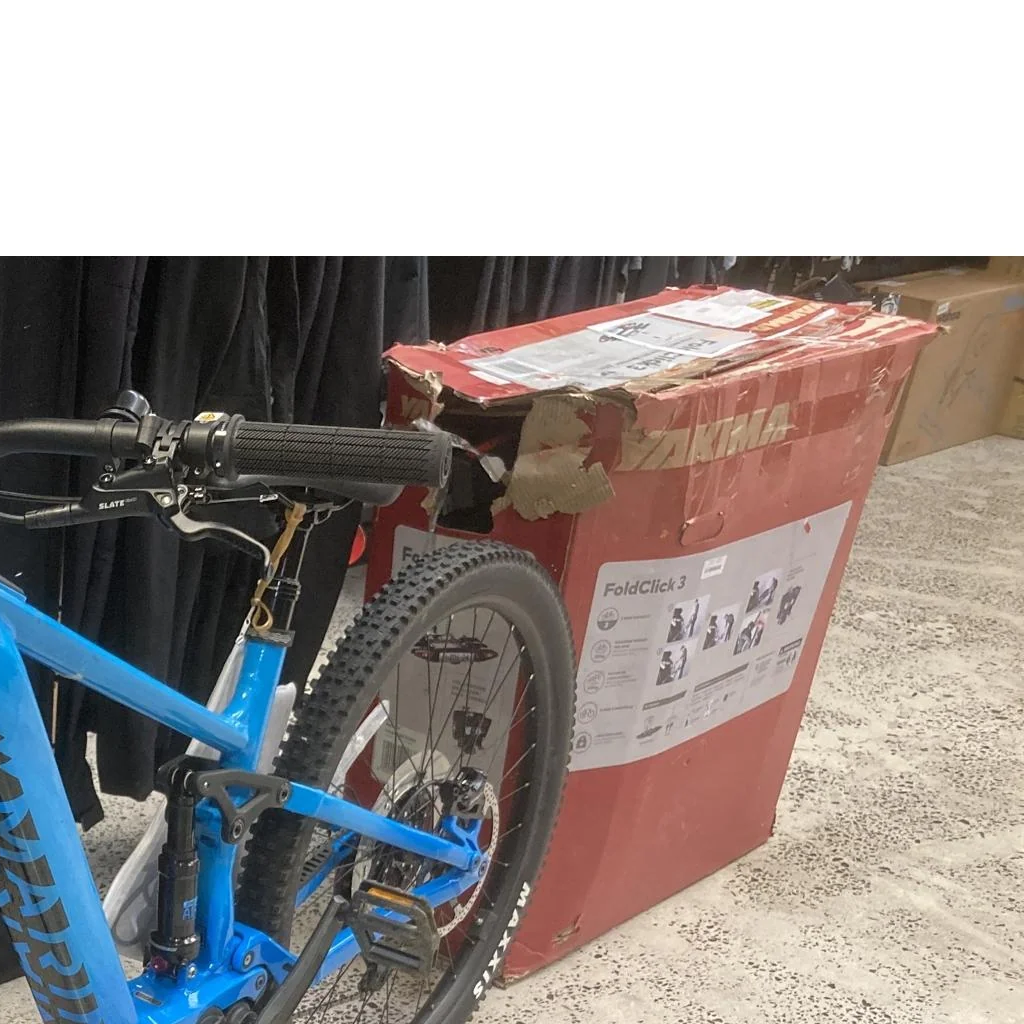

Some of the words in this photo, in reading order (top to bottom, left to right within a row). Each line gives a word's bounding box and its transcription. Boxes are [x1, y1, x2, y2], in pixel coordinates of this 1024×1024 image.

[98, 500, 125, 510] SLATE
[603, 579, 676, 597] FoldClick
[677, 575, 687, 590] 3
[473, 881, 531, 1000] MAXXIS
